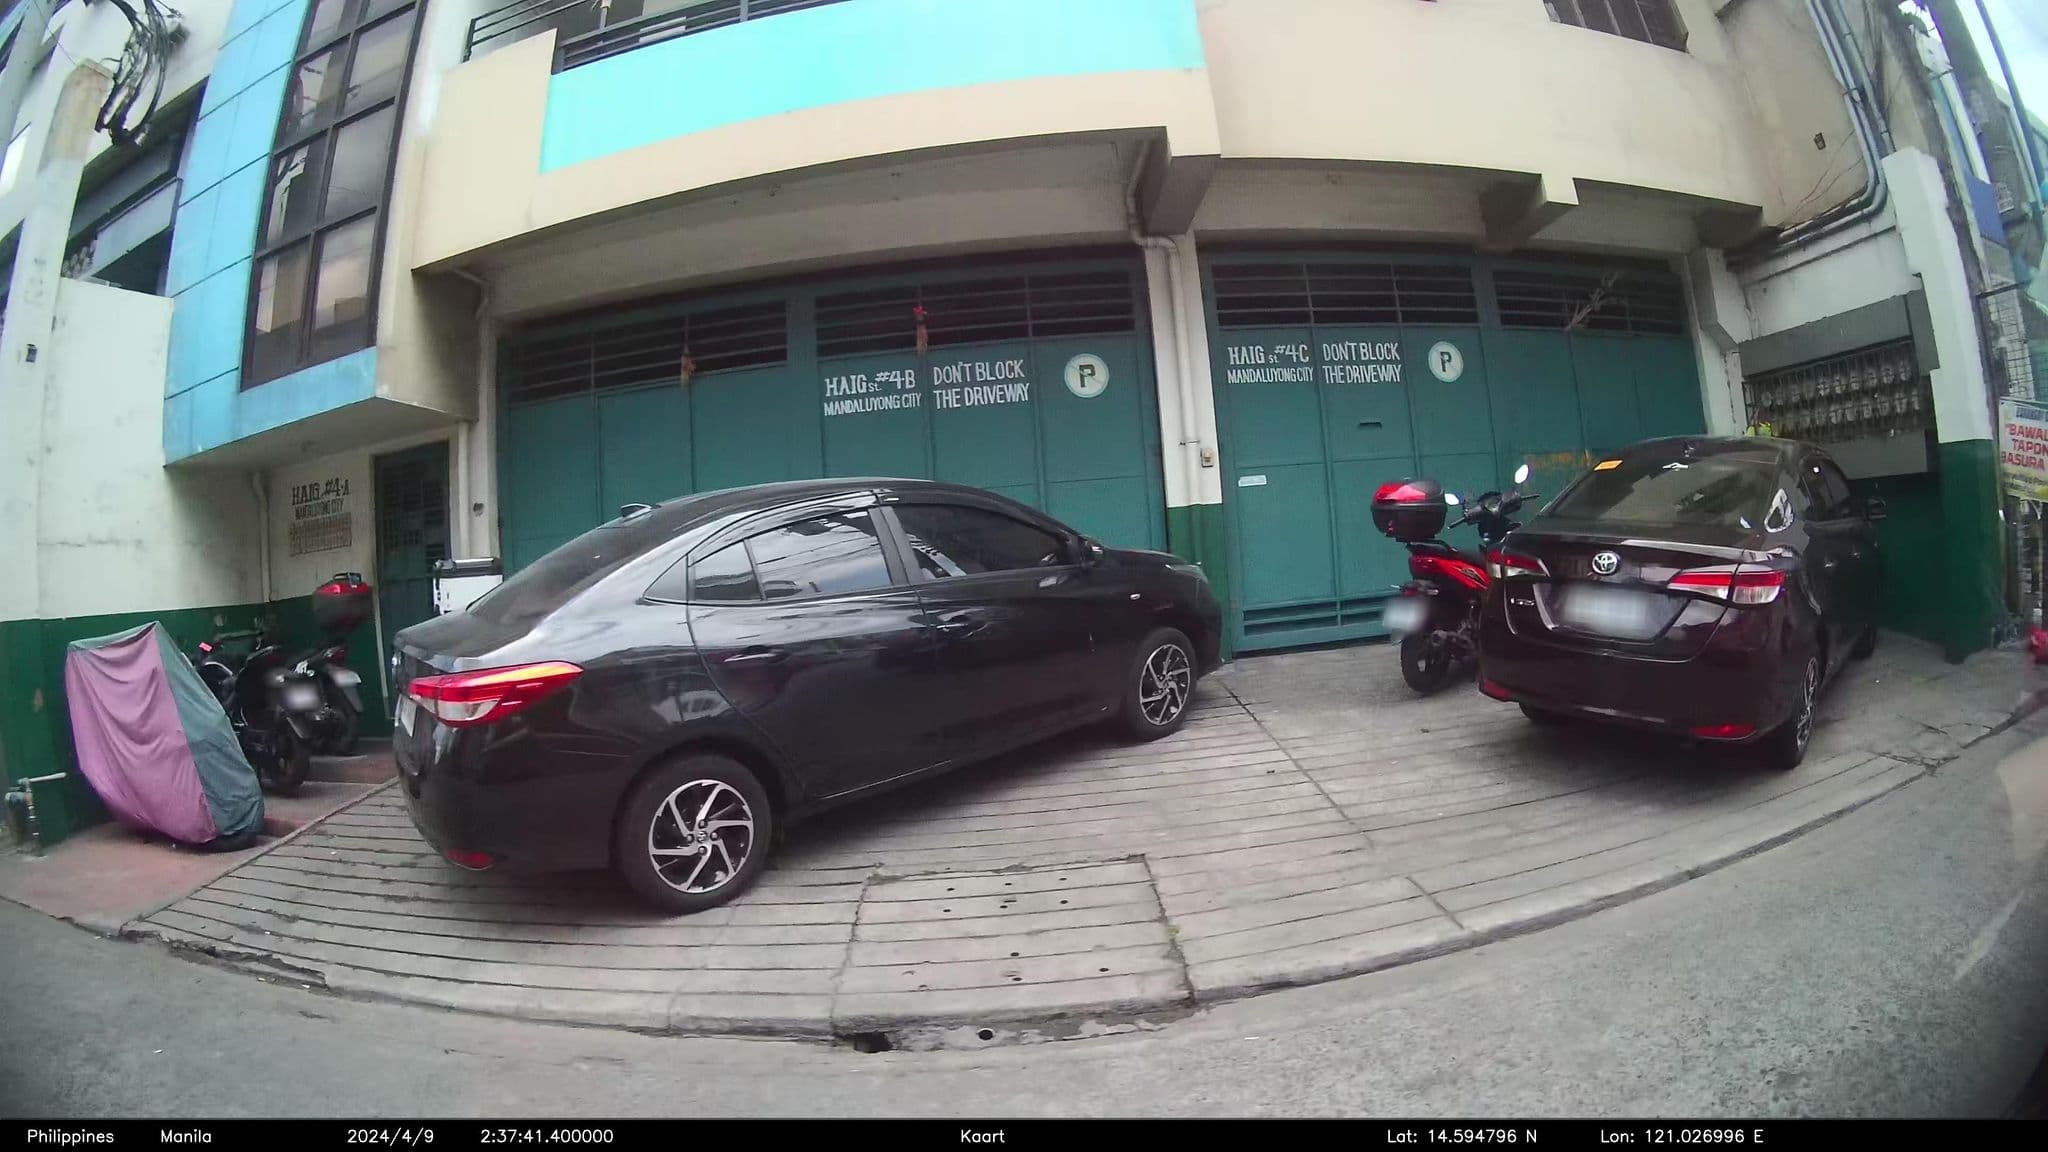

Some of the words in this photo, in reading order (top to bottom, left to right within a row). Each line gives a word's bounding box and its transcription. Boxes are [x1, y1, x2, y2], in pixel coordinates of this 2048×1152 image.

[1228, 346, 1265, 365] HAIG
[1322, 341, 1357, 362] DON'T
[1360, 342, 1401, 361] BLOCK
[1440, 351, 1453, 372] P
[933, 362, 972, 386] DON'T
[976, 359, 1025, 380] BLOCK
[1079, 363, 1096, 388] P
[1227, 367, 1296, 384] MANDALUYONG
[1297, 366, 1314, 382] CITY
[1322, 365, 1345, 384] THE
[1346, 364, 1402, 383] DRIVEWAY
[824, 374, 867, 396] HAIG
[824, 394, 901, 416] MANDALUYONG
[902, 392, 922, 408] CITY
[933, 388, 960, 410] THE
[964, 383, 1030, 407] DRIVEWAY
[292, 482, 320, 505] HAIG
